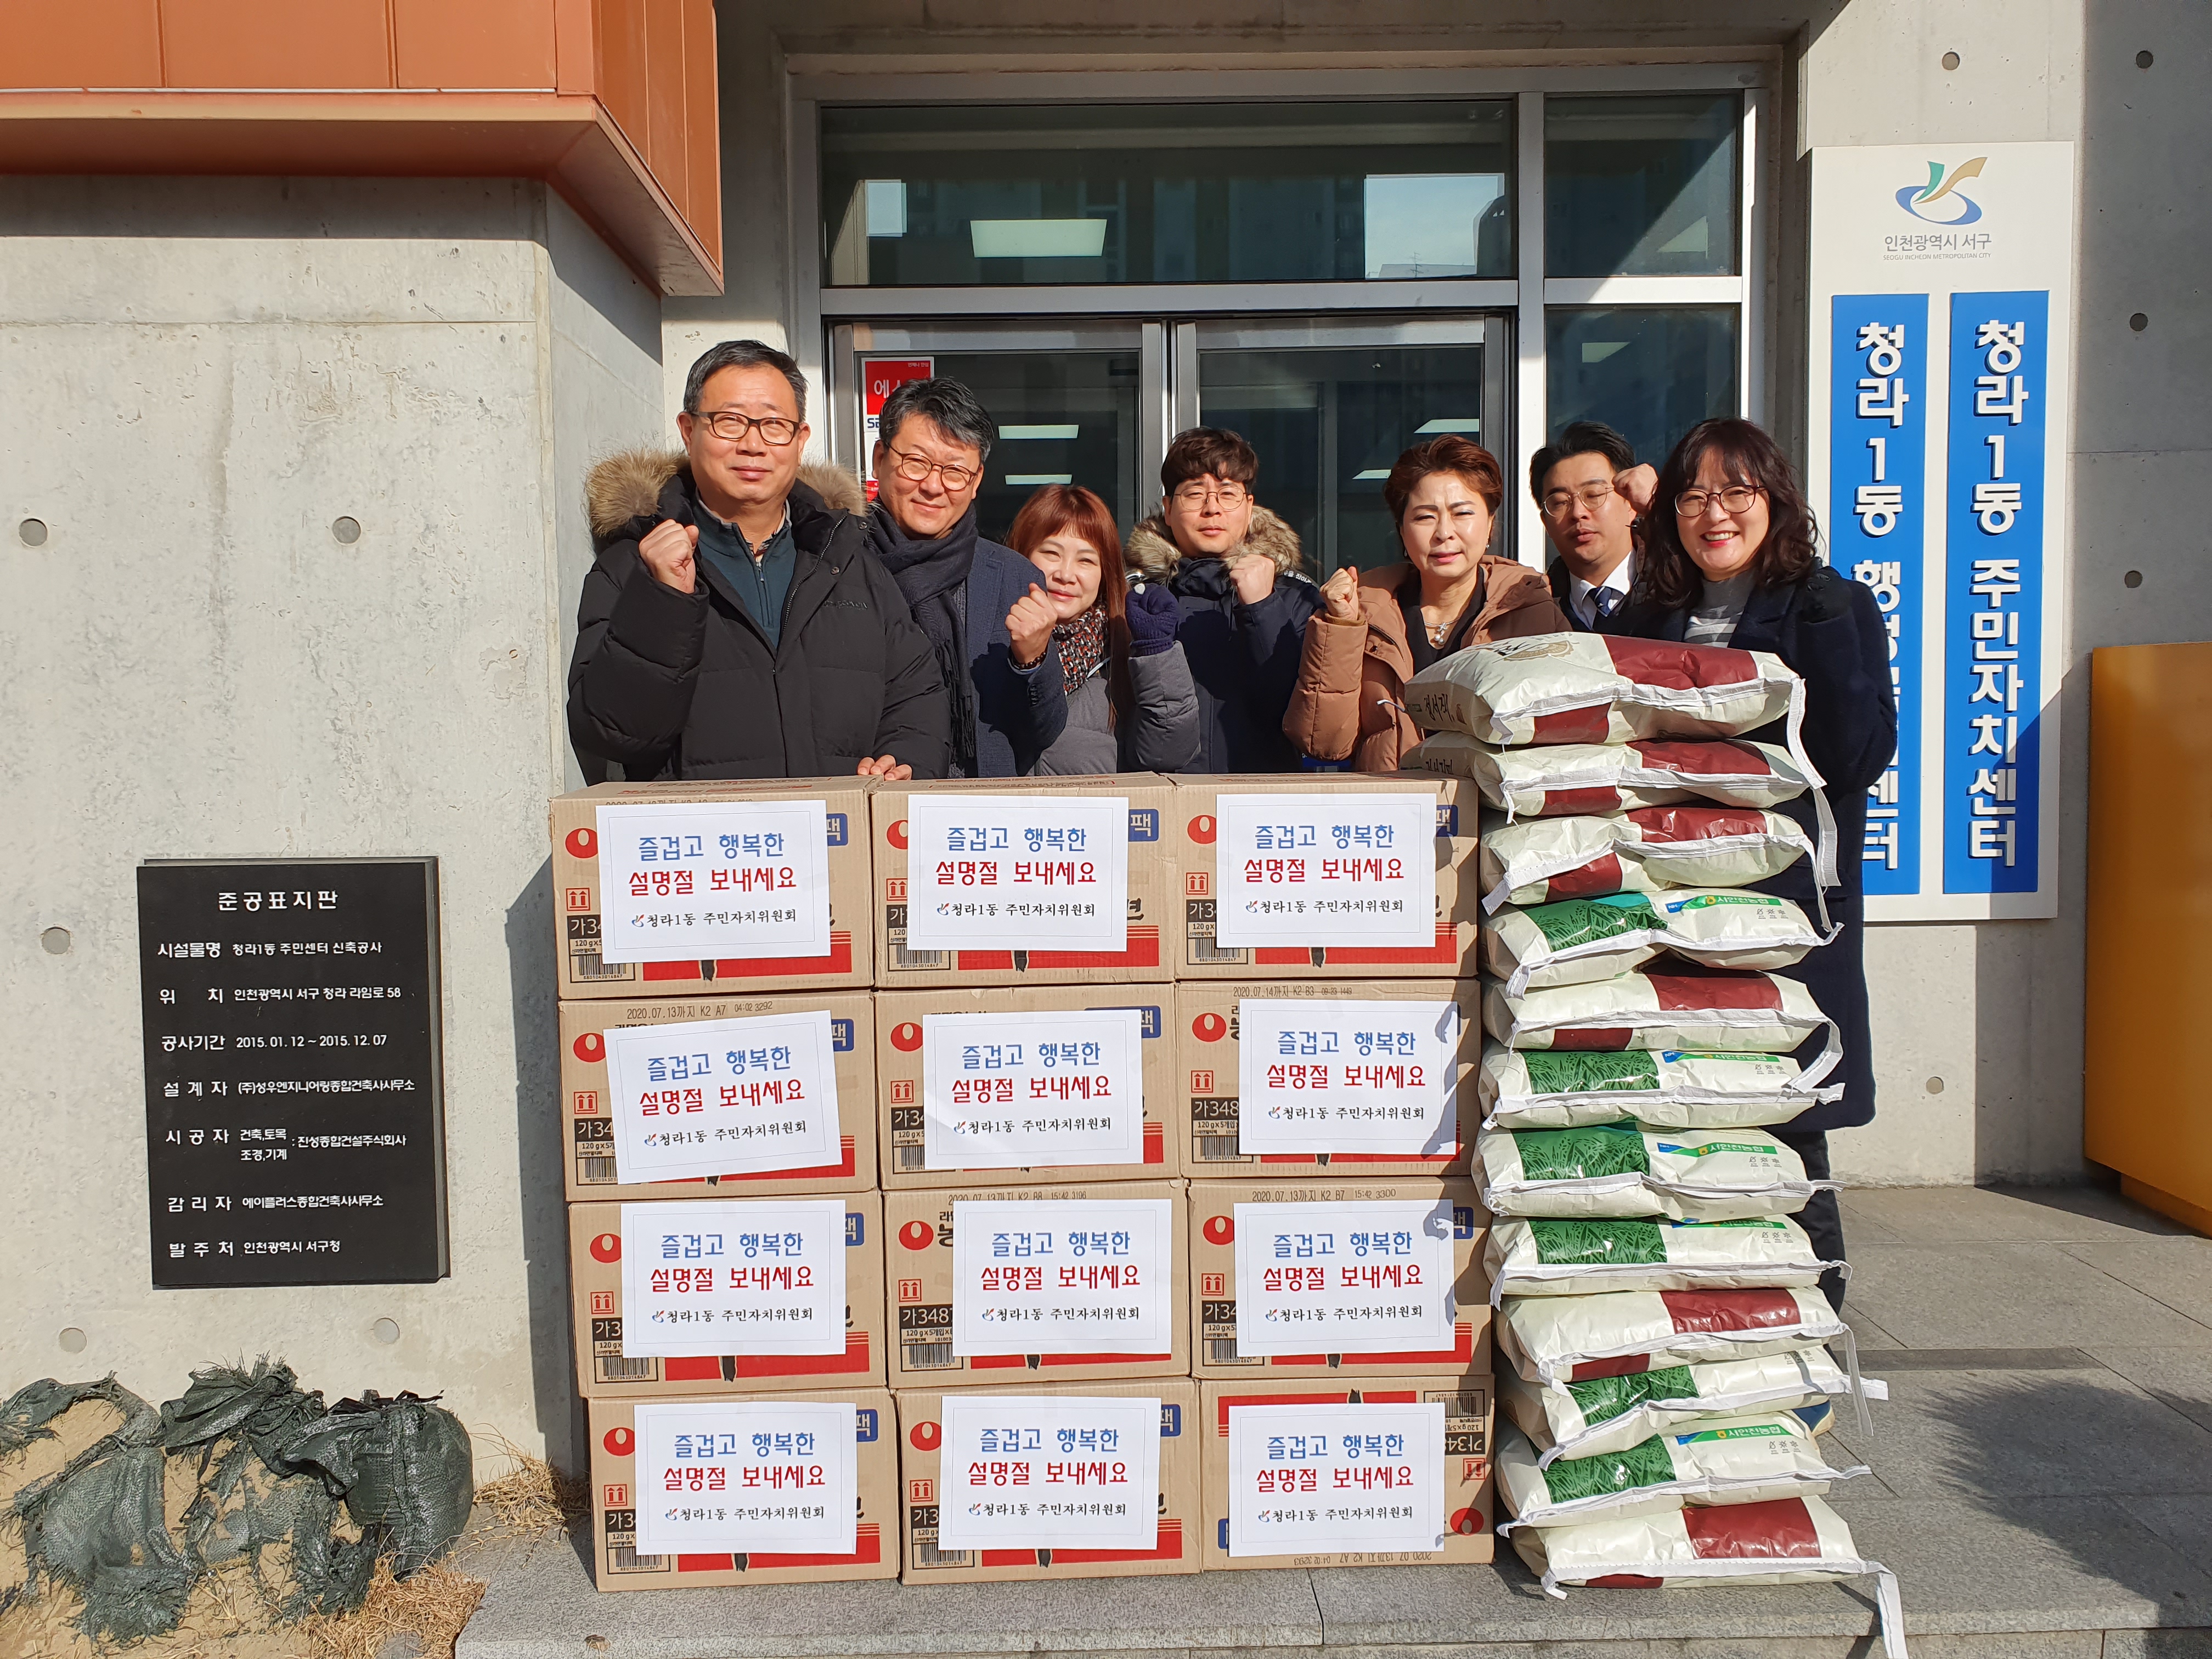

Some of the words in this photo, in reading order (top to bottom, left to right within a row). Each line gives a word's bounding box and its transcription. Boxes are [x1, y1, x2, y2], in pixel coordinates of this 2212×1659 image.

[1884, 234, 1957, 251] 인천광역시
[1961, 233, 1992, 250] 서구
[1855, 322, 1909, 536] 청라1동
[1972, 320, 2029, 535] 청라1동
[1969, 559, 2024, 867] 주민자치센터
[639, 836, 703, 861] 즐겁고
[719, 833, 784, 859] 행복한
[947, 828, 1008, 851] 즐겁고
[1024, 828, 1086, 852] 행복한
[1255, 826, 1316, 849] 즐겁고
[1332, 825, 1393, 849] 행복한
[629, 871, 693, 896] 설명절
[710, 867, 797, 892] 보내세요
[936, 862, 997, 885] 설명절
[1014, 862, 1096, 885] 보내세요
[1244, 859, 1305, 883] 설명절
[1322, 859, 1404, 882] 보내세요
[218, 890, 338, 912] 준공표지판
[952, 904, 998, 916] 청라1동
[1006, 904, 1094, 917] 주민자치위원회
[1260, 901, 1306, 913] 청라1동
[1313, 900, 1402, 913] 주민자치위원회
[647, 913, 696, 927] 청라1동
[703, 909, 795, 925] 주민자치위원회
[157, 942, 222, 958] 시설물명
[232, 943, 276, 956] 청라1동
[280, 942, 329, 955] 주민센터
[332, 941, 382, 955] 신축공사
[234, 988, 294, 1001] 인천광역시
[296, 988, 320, 1000] 서구
[323, 988, 347, 1000] 청라
[349, 987, 385, 1000] 라임로
[387, 987, 402, 999] 58
[1233, 985, 1289, 998] 2020.07.14까지
[1293, 985, 1302, 996] K2
[627, 1005, 696, 1020] 2020.07.13까지
[700, 1006, 712, 1017] K2
[715, 1005, 726, 1016] A7
[734, 1002, 753, 1013] 04:02
[755, 1001, 773, 1012] 3292
[161, 1035, 226, 1052] 공사기간
[962, 1045, 1023, 1069] 즐겁고
[1039, 1042, 1100, 1067] 행복한
[1278, 1031, 1339, 1054] 즐겁고
[1355, 1032, 1415, 1056] 행복한
[648, 1054, 712, 1081] 즐겁고
[726, 1046, 791, 1075] 행복한
[238, 1079, 415, 1095] (주)성우엔지니어링종합건축사사무소
[1267, 1065, 1328, 1089] 설명절
[1344, 1066, 1425, 1088] 보내세요
[640, 1088, 703, 1116] 설명절
[720, 1079, 805, 1107] 보내세요
[952, 1079, 1013, 1103] 설명절
[1030, 1076, 1111, 1100] 보내세요
[1283, 1107, 1329, 1120] 청라1동
[1336, 1107, 1423, 1120] 주민자치위원회
[239, 1128, 287, 1142] 건축,토목
[660, 1131, 707, 1146] 청라1동
[715, 1120, 805, 1141] 주민자치위원회
[968, 1121, 1014, 1134] 청라1동
[1022, 1118, 1110, 1132] 주민자치위원회
[297, 1135, 407, 1148] 진성종합건설주식회사
[240, 1149, 287, 1162] 조경,기계
[242, 1194, 384, 1209] 에이플러스종합건축사사무소
[1252, 1190, 1316, 1202] 2020.07.13까지
[1321, 1190, 1331, 1201] K2
[1335, 1189, 1345, 1200] B7
[1355, 1189, 1372, 1199] 15:42
[1375, 1188, 1396, 1199] 3300
[244, 1242, 302, 1254] 인천광역시
[306, 1240, 341, 1253] 서구청
[662, 1234, 724, 1258] 즐겁고
[740, 1233, 803, 1257] 행복한
[992, 1233, 1053, 1256] 즐겁고
[1069, 1232, 1130, 1256] 행복한
[1274, 1234, 1335, 1257] 즐겁고
[1350, 1232, 1412, 1256] 행복한
[651, 1268, 713, 1293] 설명절
[730, 1266, 814, 1290] 보내세요
[981, 1267, 1042, 1291] 설명절
[1058, 1265, 1140, 1289] 보내세요
[1263, 1267, 1324, 1291] 설명절
[1341, 1265, 1423, 1288] 보내세요
[667, 1311, 714, 1323] 청라1동
[722, 1308, 811, 1322] 주민자치위원회
[997, 1308, 1043, 1321] 청라1동
[1051, 1307, 1138, 1320] 주민자치위원회
[1280, 1309, 1326, 1322] 청라1동
[1334, 1305, 1421, 1320] 주민자치위원회
[675, 1434, 736, 1458] 즐겁고
[752, 1432, 815, 1457] 행복한
[980, 1429, 1041, 1452] 즐겁고
[1057, 1429, 1119, 1453] 행복한
[1267, 1436, 1328, 1459] 즐겁고
[1343, 1434, 1404, 1458] 행복한
[664, 1468, 725, 1491] 설명절
[742, 1465, 825, 1489] 보내세요
[968, 1462, 1029, 1486] 설명절
[1046, 1462, 1127, 1485] 보내세요
[1257, 1469, 1317, 1493] 설명절
[1333, 1466, 1413, 1489] 보내세요
[680, 1509, 727, 1521] 청라1동
[734, 1506, 823, 1520] 주민자치위원회
[984, 1504, 1030, 1516] 청라1동
[1037, 1503, 1125, 1516] 주민자치위원회
[1273, 1510, 1318, 1522] 청라1동
[1325, 1506, 1412, 1520] 주민자치위원회
